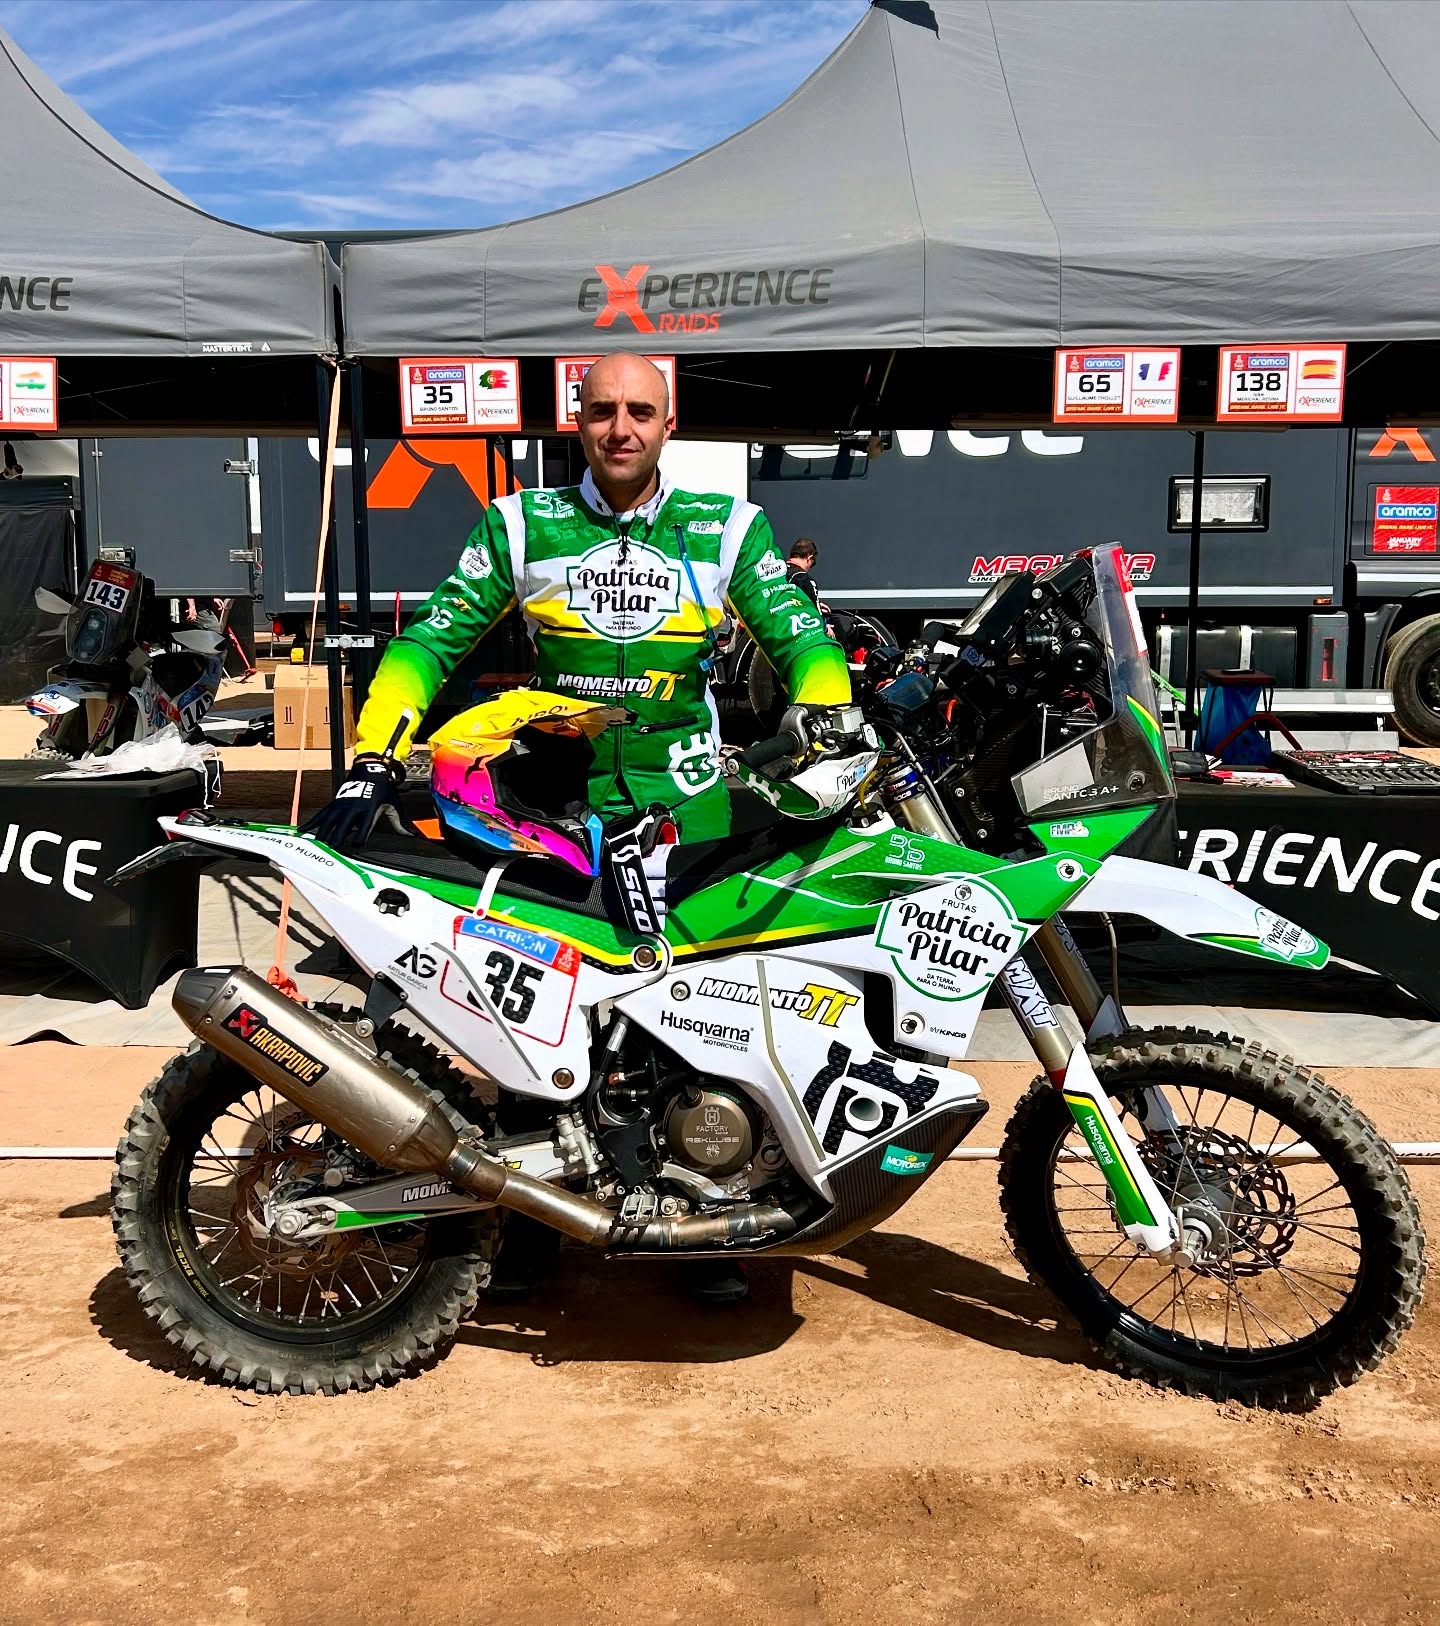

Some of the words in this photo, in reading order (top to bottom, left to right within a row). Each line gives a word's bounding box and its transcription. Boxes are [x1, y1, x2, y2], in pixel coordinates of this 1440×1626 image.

[577, 265, 834, 334] EXPERIENCE
[658, 312, 722, 334] RAIDS
[202, 344, 253, 353] MASTERTENT
[1251, 358, 1286, 366] aramco
[428, 370, 462, 379] aramco
[1078, 374, 1111, 393] 65
[1236, 373, 1282, 391] 138
[423, 385, 453, 404] 35
[1135, 398, 1172, 408] EXPERIENCE
[1298, 396, 1337, 406] EXPERIENCE
[477, 407, 514, 418] EXPERIENCE
[1381, 506, 1432, 517] aramco
[577, 568, 670, 590] Patrícia
[87, 582, 126, 610] 143
[591, 589, 657, 614] Pilar
[556, 673, 651, 693] MOMENTO
[639, 669, 687, 701] TT
[1043, 784, 1079, 795] BRUNO
[1051, 823, 1076, 836] FMP
[296, 846, 335, 867] MUNDO
[1178, 829, 1440, 921] RIENCE
[942, 898, 977, 914] FRUTAS
[898, 902, 1012, 954] Patrícia
[474, 923, 547, 954] CATRION
[393, 944, 438, 979] AG
[907, 931, 989, 976] Pilar
[387, 964, 407, 978] ARTUR
[406, 975, 428, 991] GARCIA
[467, 950, 546, 1024] 35
[916, 976, 932, 985] PARA
[938, 983, 961, 994] MUNDO
[936, 975, 954, 985] TERRA
[696, 977, 811, 1012] MOMNTO
[798, 982, 861, 1028] TT
[660, 1010, 751, 1043] Husqvarna
[702, 1038, 748, 1053] MOTORCYCLES
[696, 1125, 729, 1133] FACTORY
[1084, 1115, 1114, 1165] Husqvarna
[886, 1155, 928, 1169] MOTOREX
